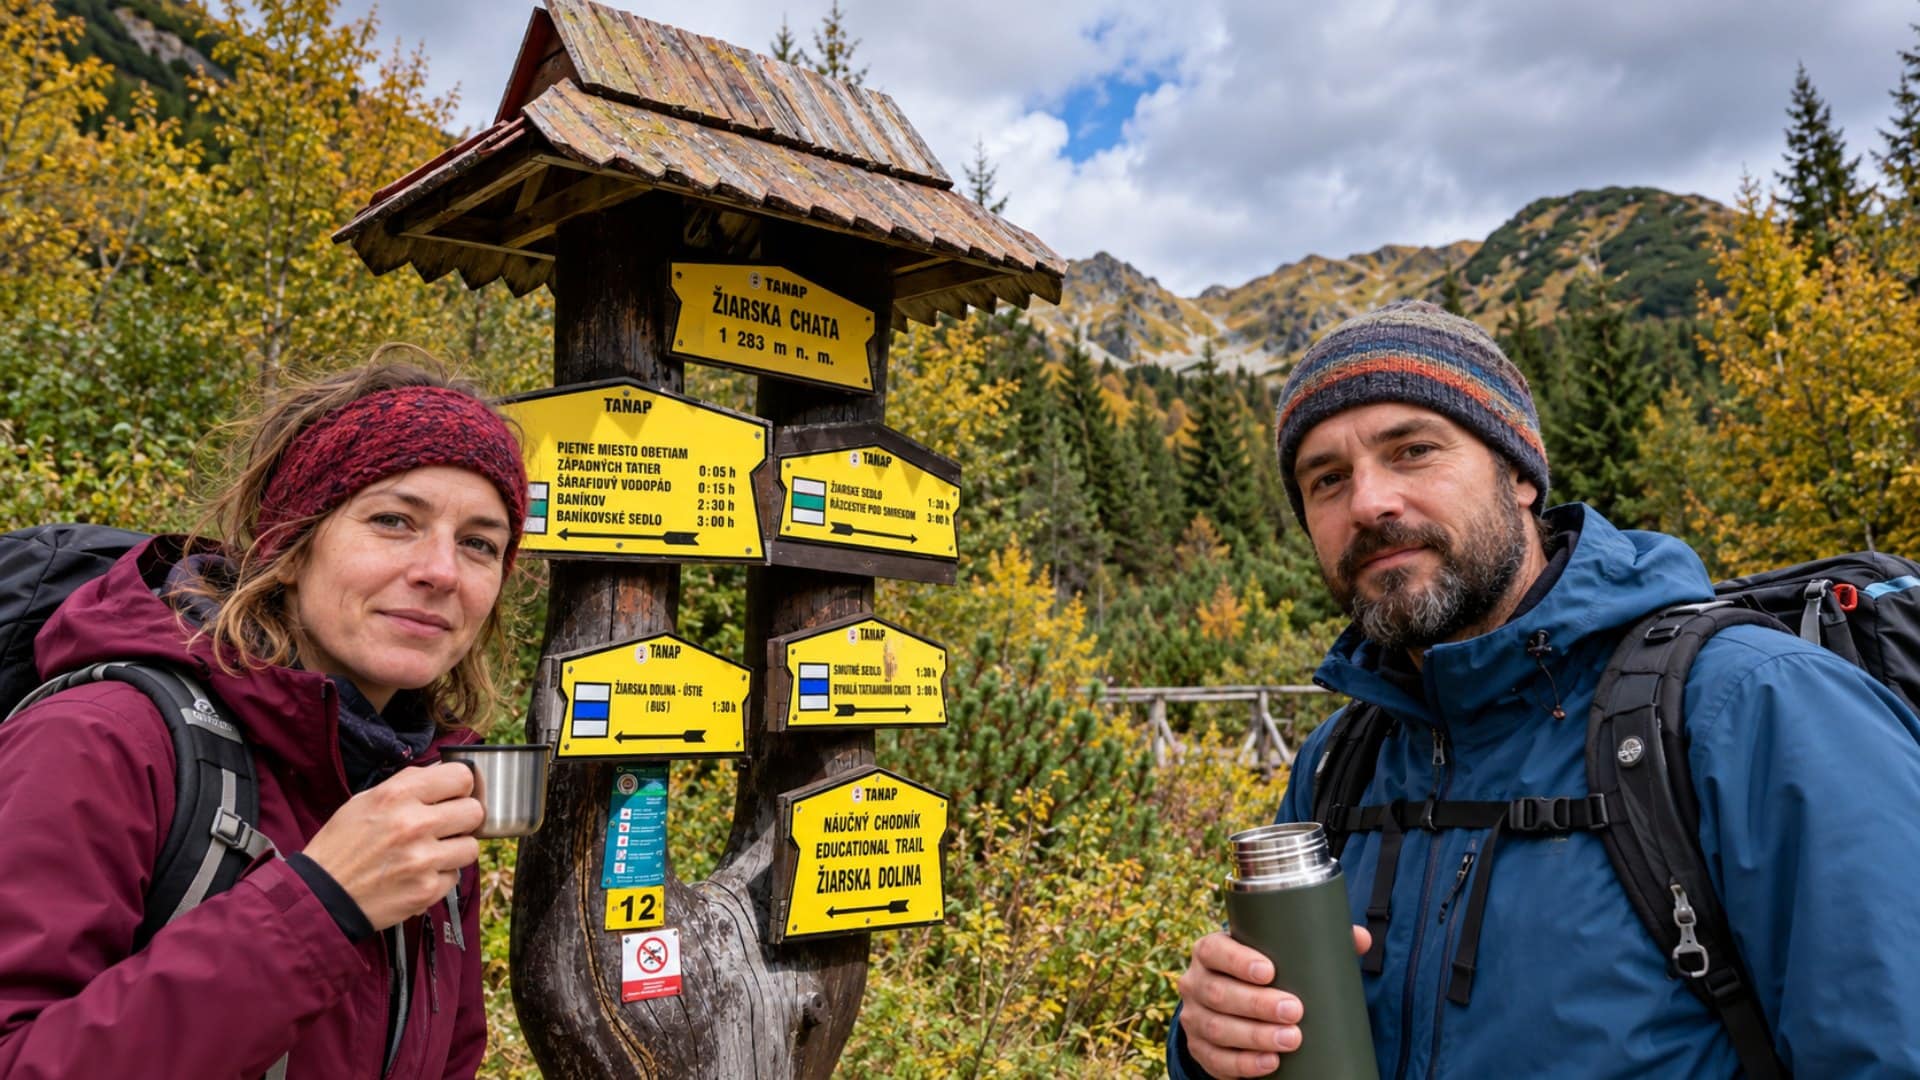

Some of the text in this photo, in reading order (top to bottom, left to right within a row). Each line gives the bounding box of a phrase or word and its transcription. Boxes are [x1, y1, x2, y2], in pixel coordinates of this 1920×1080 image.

[765, 278, 807, 299] TANAP
[713, 285, 840, 340] ŽIARSKA CHATA
[719, 327, 834, 365] 1 283 m n. m.
[604, 397, 652, 414] TANAP
[598, 443, 638, 457] MIESTO
[641, 446, 688, 459] OBETIAM
[863, 451, 892, 468] TANAP
[557, 457, 736, 478] ZÁPADNÝCH TATIER 0:05 h
[621, 478, 671, 492] VODOPÁD
[698, 482, 725, 494] 0:15
[728, 483, 735, 495] h
[557, 491, 734, 511] BANÍKOV 2:30 h
[868, 504, 882, 515] POD
[556, 508, 734, 528] BANÍKOVSKÉ SEDLO 3:00 h
[860, 628, 885, 641] TANAP
[650, 643, 681, 660] TANAP
[615, 680, 647, 695] ŽIARSKA
[650, 683, 676, 696] DOLINA
[712, 701, 730, 713] 1:30
[731, 701, 737, 713] h
[865, 787, 898, 801] TANAP
[823, 810, 921, 833] NÁUČNÝ CHODNÍK
[816, 837, 924, 860] EDUCATIONAL TRAIL
[816, 864, 922, 894] ŽIARSKA DOLINA
[620, 894, 656, 922] 12
